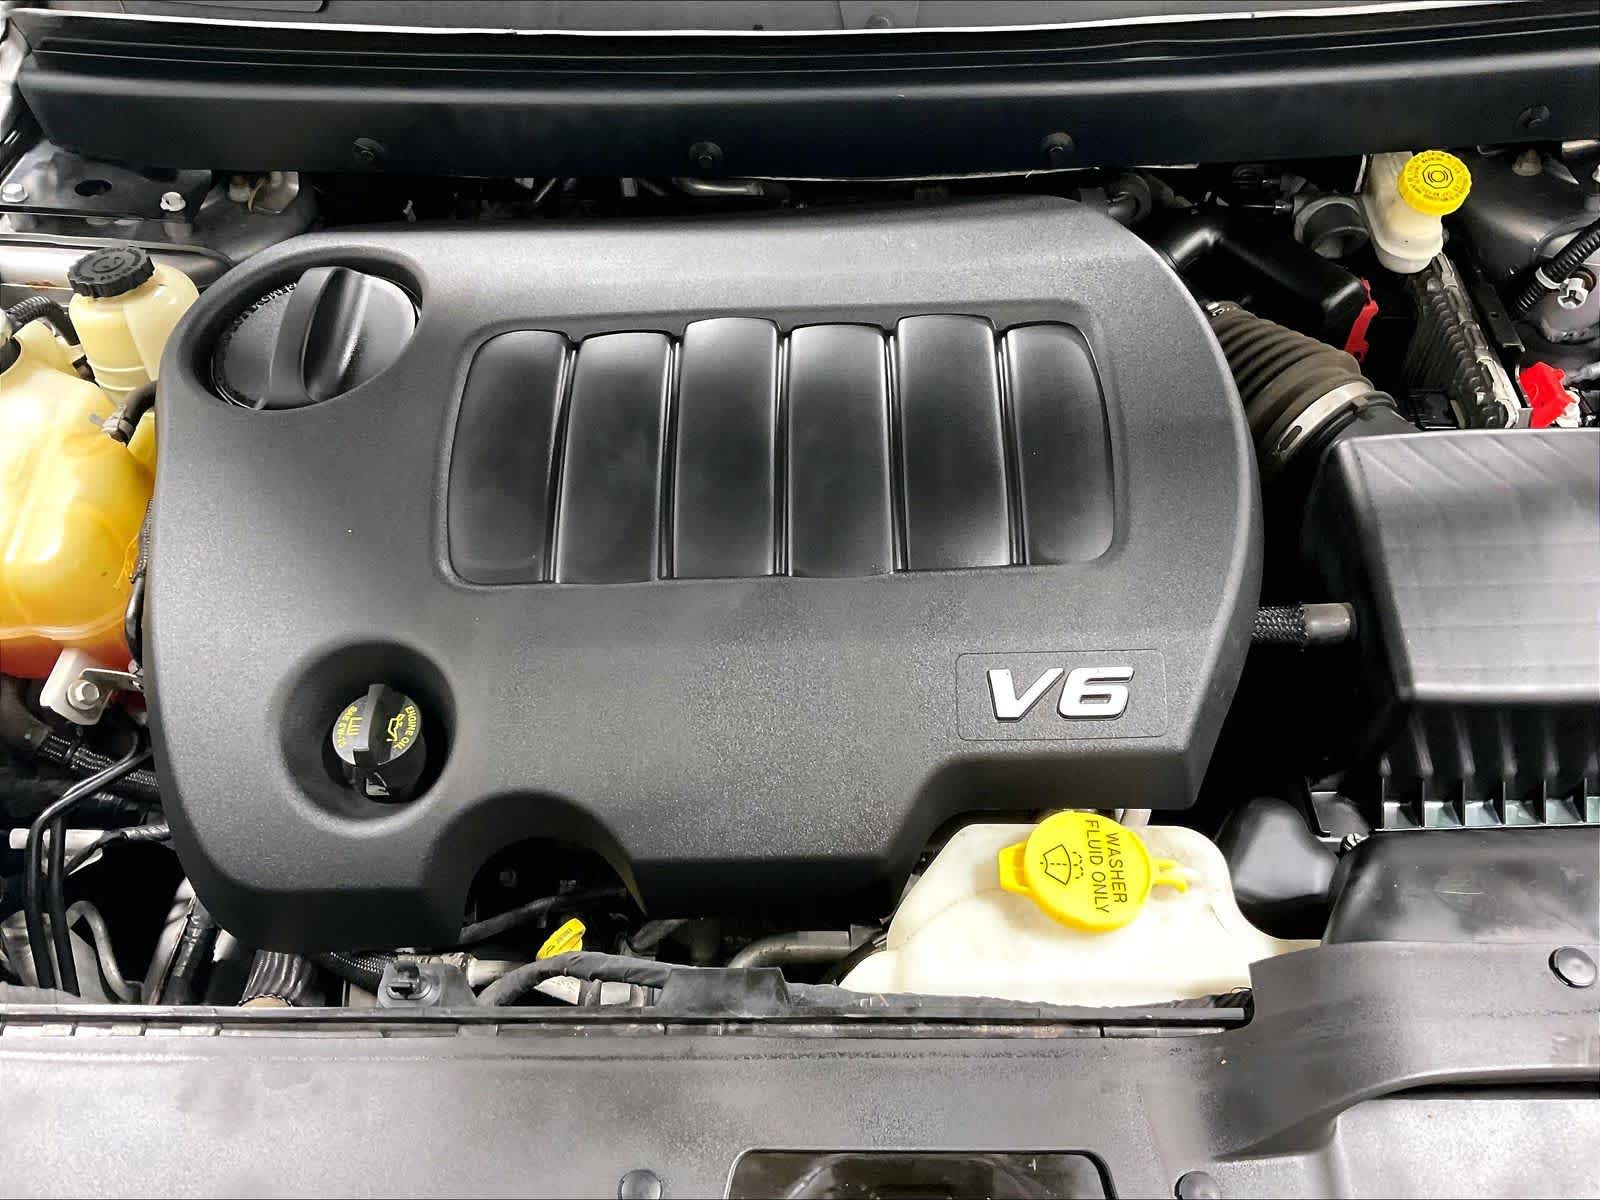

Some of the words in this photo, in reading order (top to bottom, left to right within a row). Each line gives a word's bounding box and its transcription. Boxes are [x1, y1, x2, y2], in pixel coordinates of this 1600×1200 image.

[987, 667, 1135, 722] V6
[404, 705, 417, 735] ENGINE
[393, 736, 410, 750] OIL
[1085, 819, 1104, 865] FLUID
[1105, 832, 1128, 904] WASHER
[1091, 871, 1110, 914] ONLY
